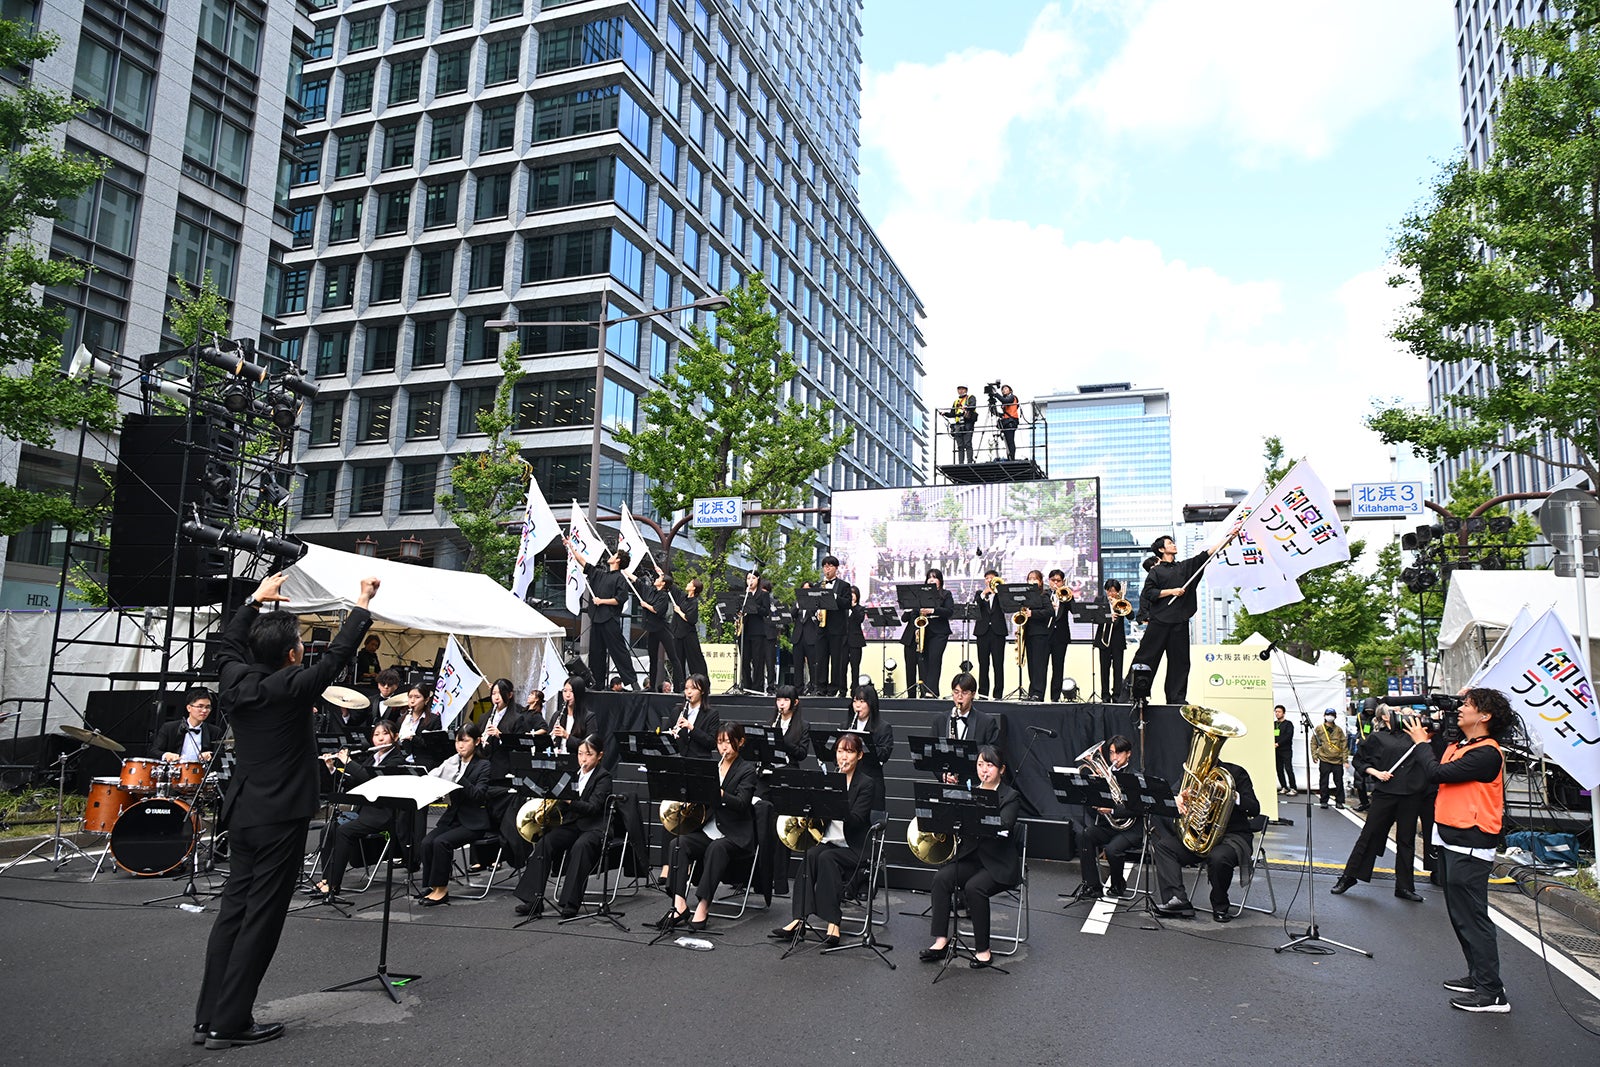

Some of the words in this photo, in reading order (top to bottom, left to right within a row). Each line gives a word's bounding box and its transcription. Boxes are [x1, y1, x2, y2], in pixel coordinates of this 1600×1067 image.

[1359, 485, 1414, 502] 北浜3
[698, 500, 736, 515] 北浜3
[1358, 503, 1418, 512] Kitahama-3
[697, 515, 737, 523] Kitahama-3
